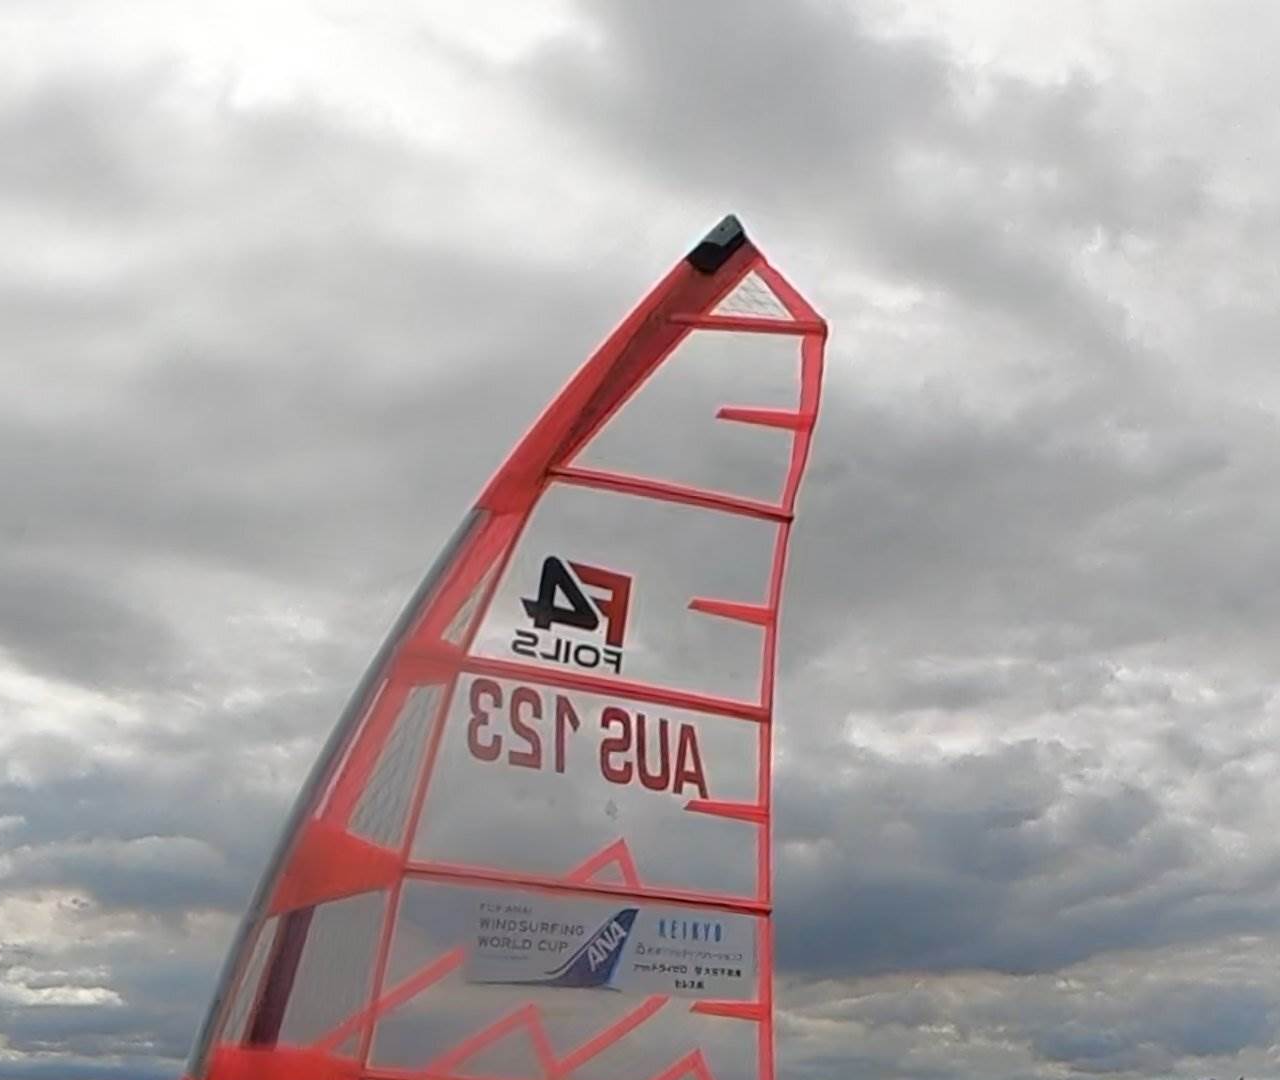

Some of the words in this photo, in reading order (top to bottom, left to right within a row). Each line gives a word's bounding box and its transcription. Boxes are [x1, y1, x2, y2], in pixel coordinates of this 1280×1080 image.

[478, 917, 586, 937] WINDSURFING
[477, 935, 533, 951] WORLD
[537, 940, 570, 954] CUP
[586, 920, 628, 972] ANA
